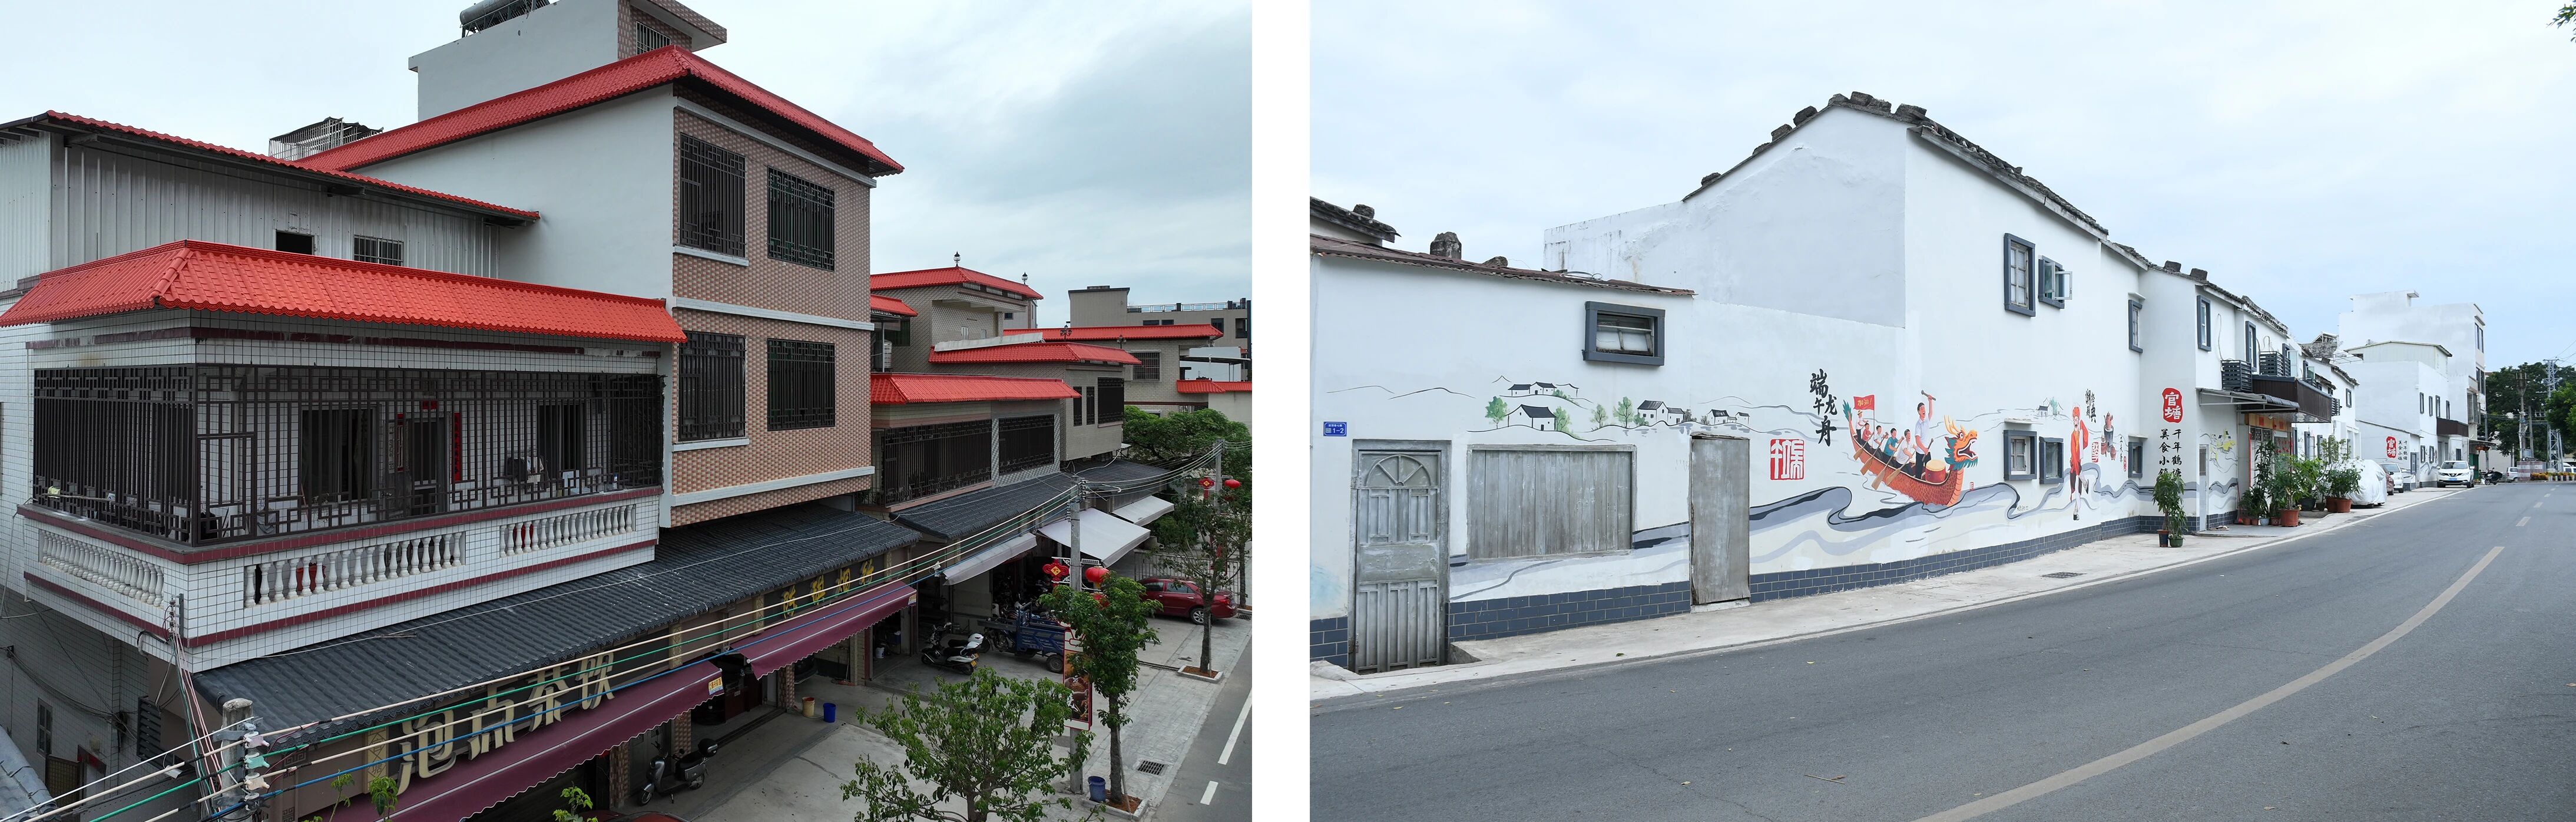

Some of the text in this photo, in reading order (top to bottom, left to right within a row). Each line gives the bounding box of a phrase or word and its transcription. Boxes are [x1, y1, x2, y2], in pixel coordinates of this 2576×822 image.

[2165, 392, 2181, 420] 官塘
[397, 652, 615, 795] 泡点茶饮
